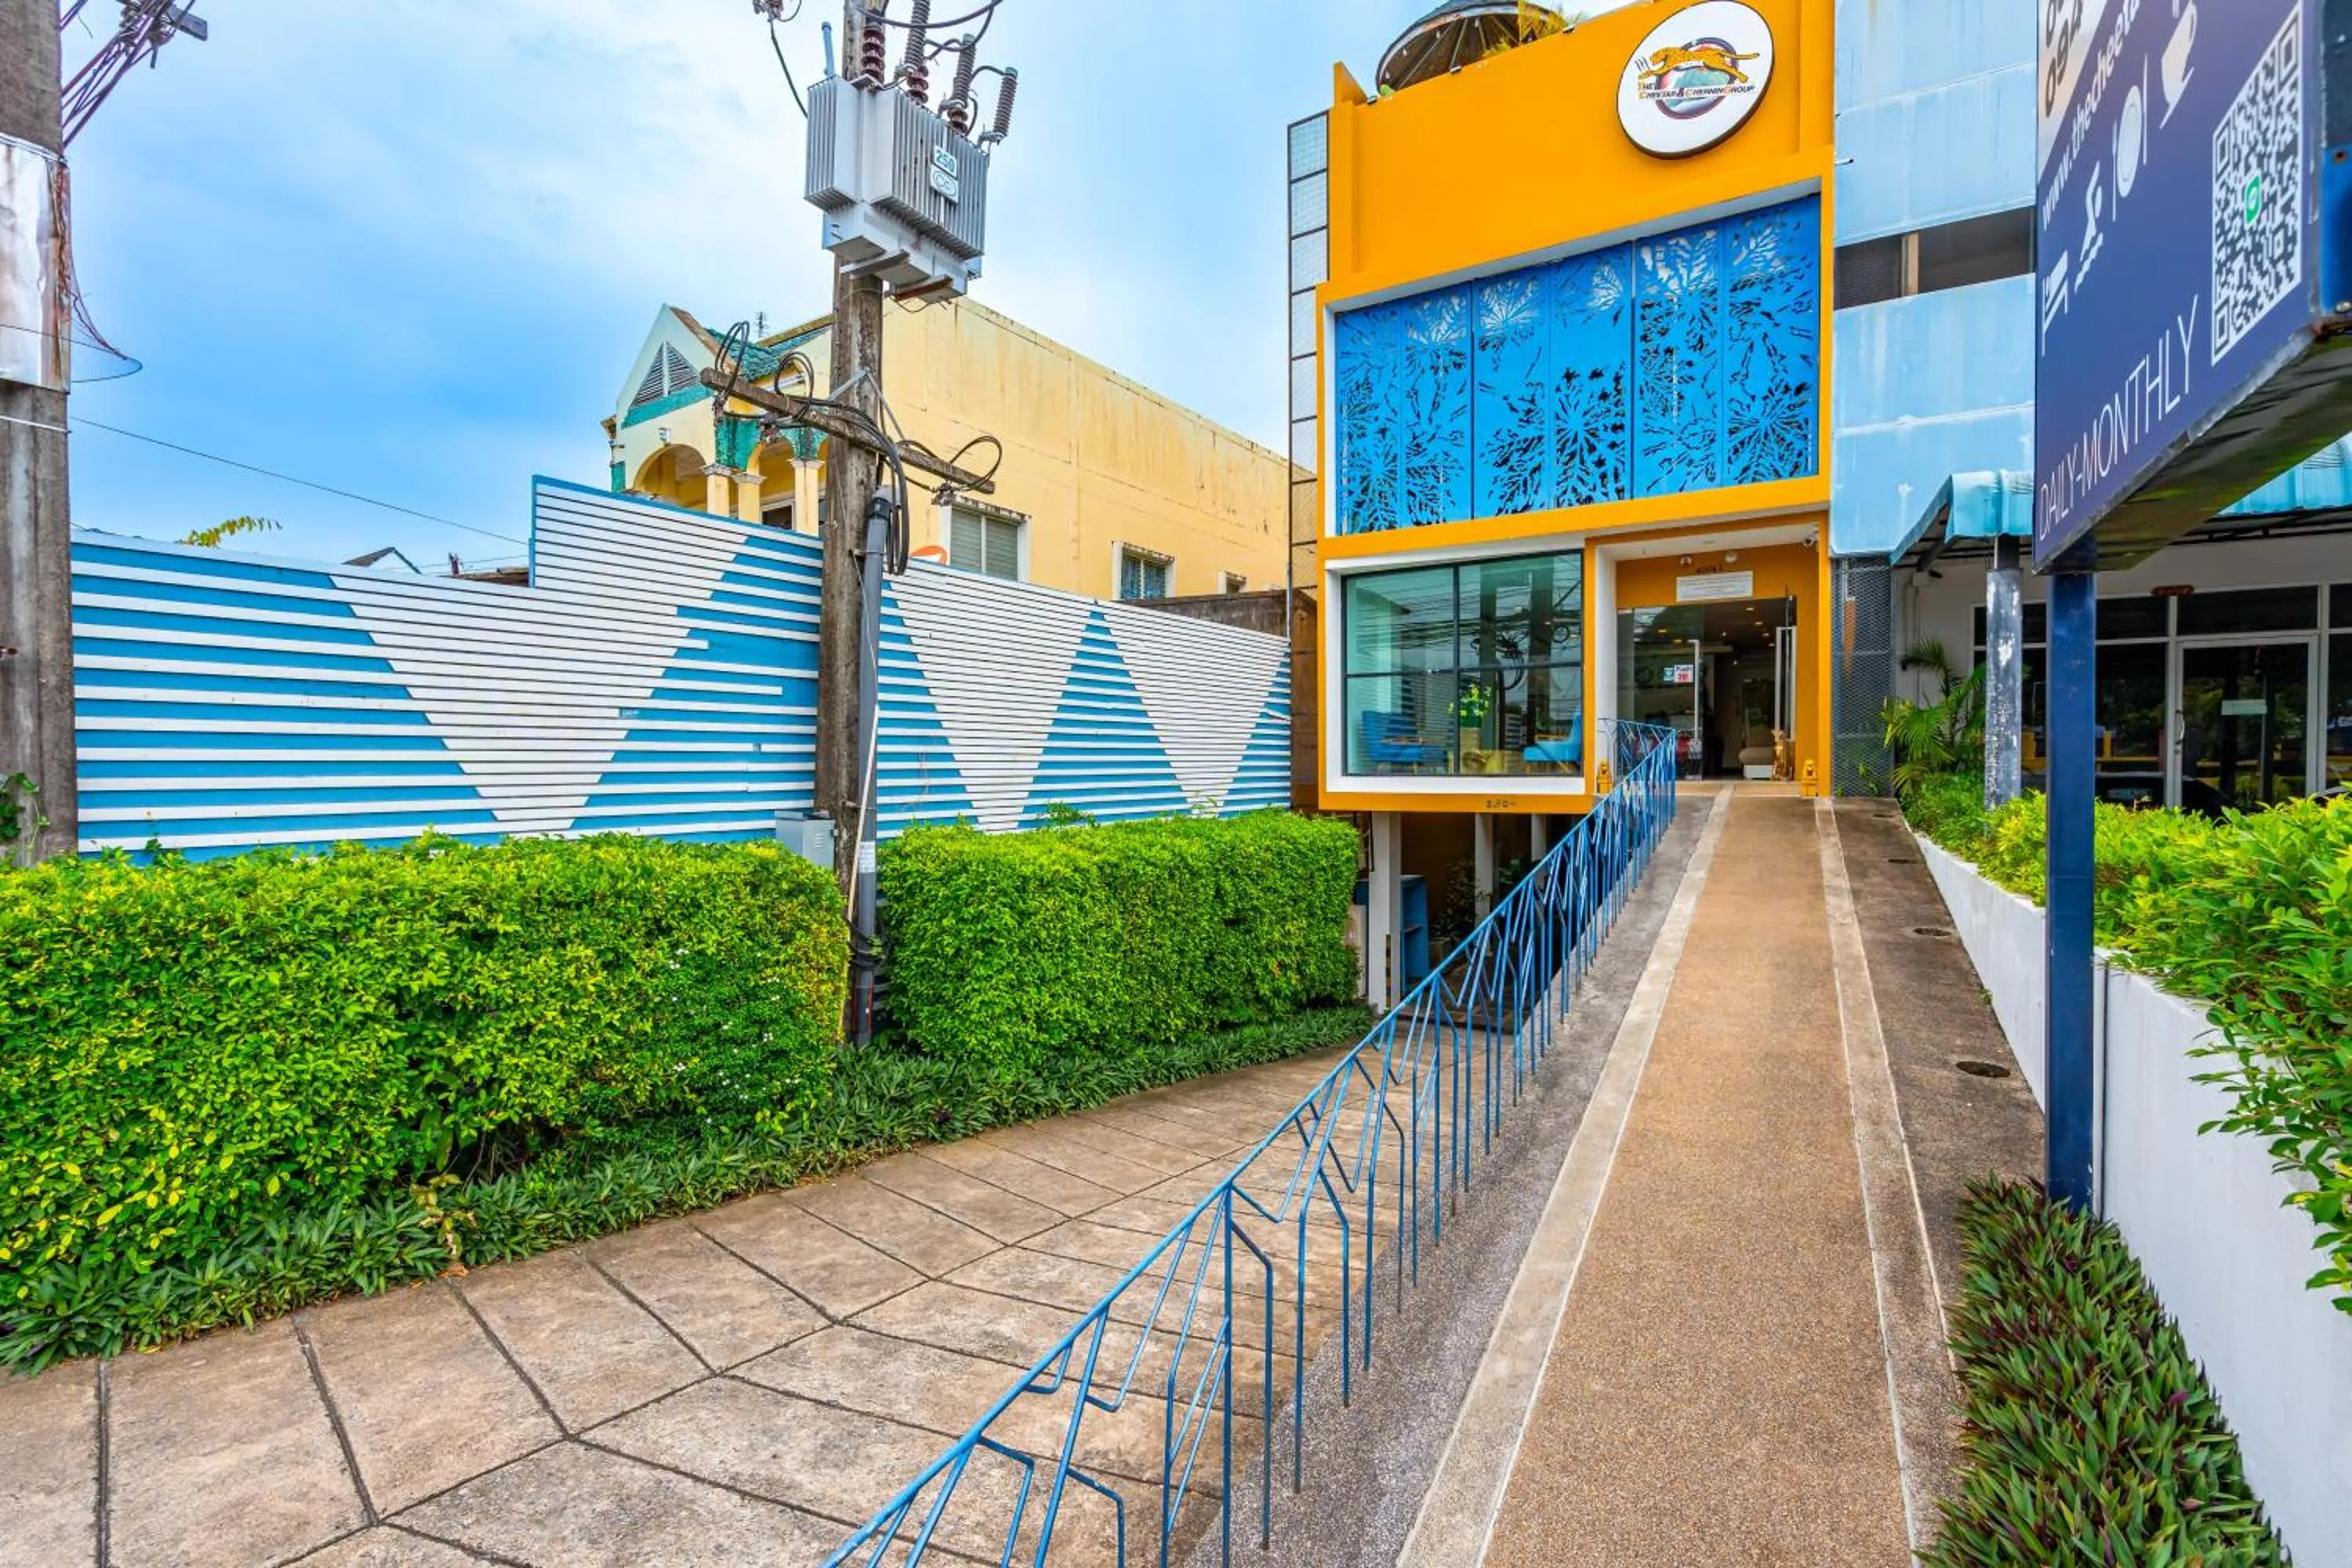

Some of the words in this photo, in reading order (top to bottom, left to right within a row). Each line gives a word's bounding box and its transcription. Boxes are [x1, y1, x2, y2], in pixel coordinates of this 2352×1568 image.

[2045, 0, 2064, 48] 0
[1638, 82, 1655, 91] THE
[1676, 87, 1684, 97] &
[1723, 84, 1755, 95] GROUP
[2039, 294, 2198, 542] DAILY-MONTHLY
